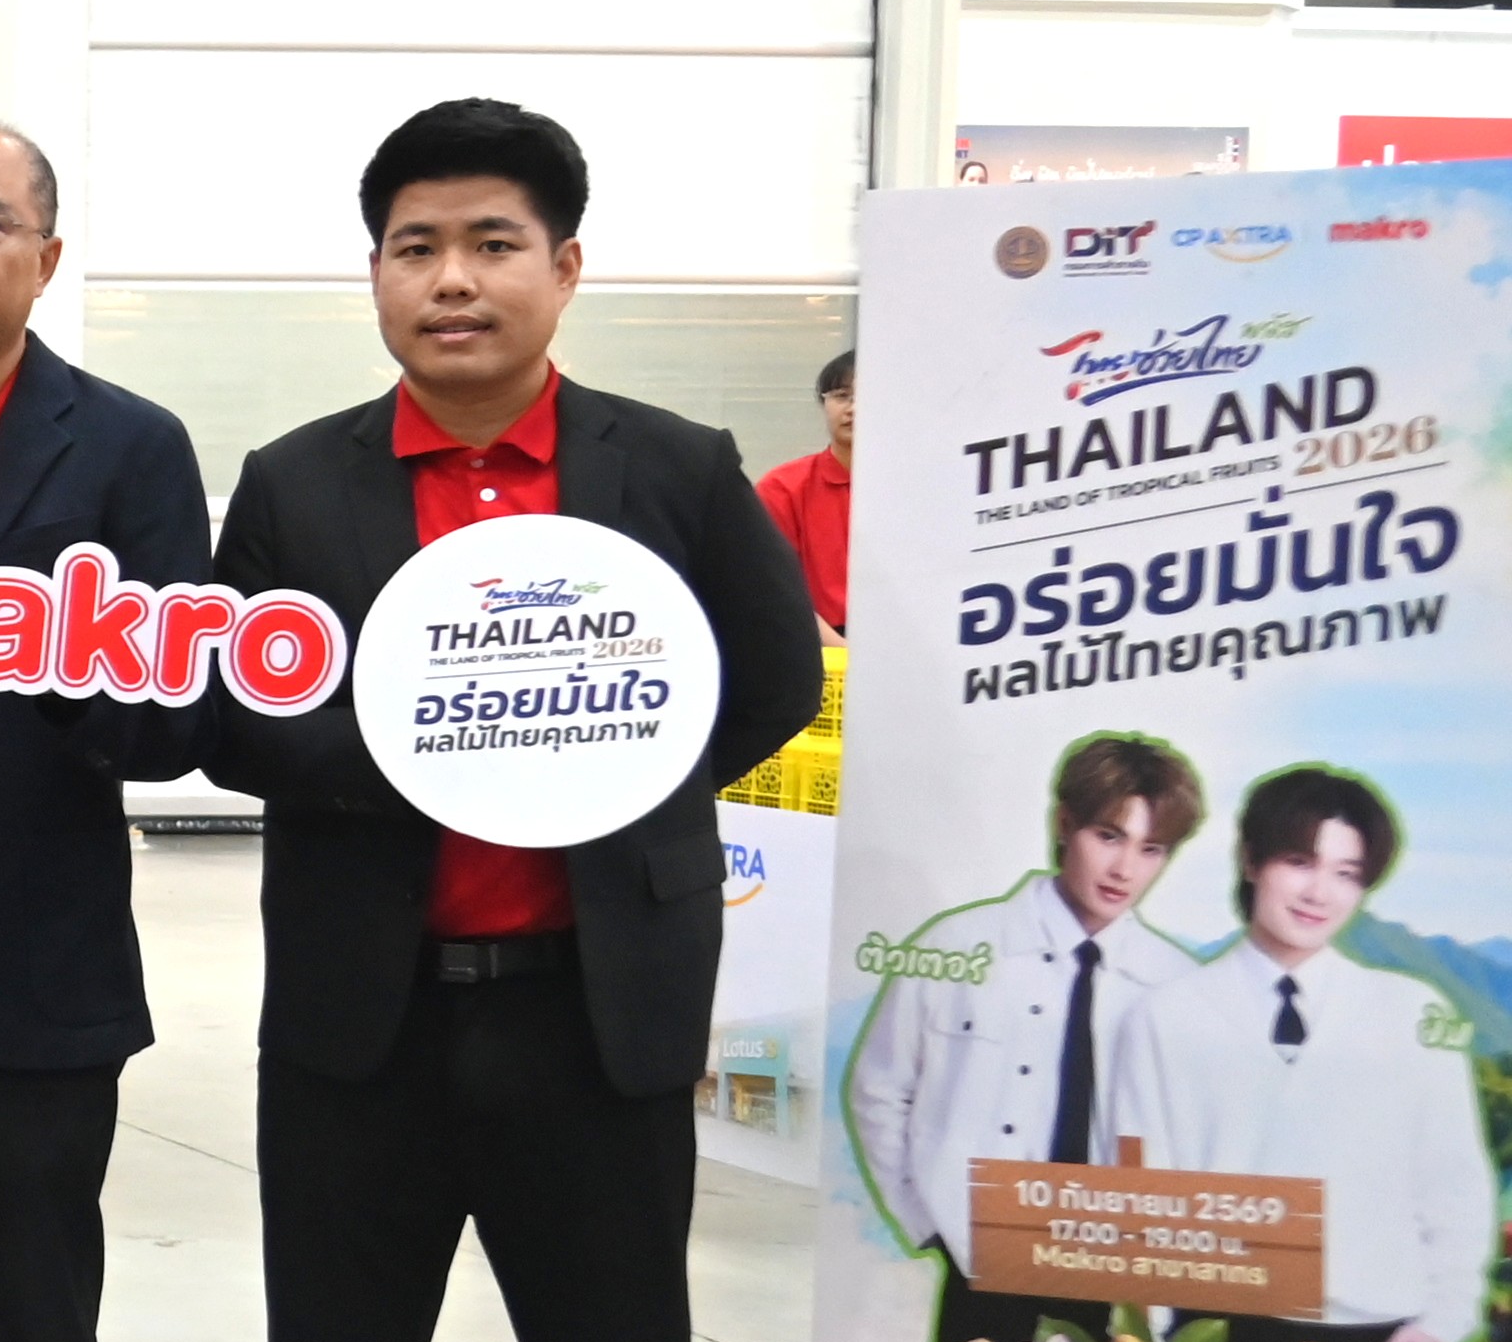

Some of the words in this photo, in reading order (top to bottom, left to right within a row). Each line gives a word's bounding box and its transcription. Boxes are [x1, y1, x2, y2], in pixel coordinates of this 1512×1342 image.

[1329, 216, 1429, 243] makro
[964, 365, 1378, 497] THAILAND
[1292, 415, 1439, 477] 2026
[975, 504, 1011, 526] THE
[1016, 493, 1071, 519] LAND
[1074, 487, 1103, 508] OF
[1106, 469, 1205, 504] TROPICAL
[1208, 455, 1280, 484] FRUITS
[958, 485, 1461, 647] อร่อยมั่นใจ
[426, 610, 636, 652] THAILAND
[592, 636, 664, 660] 2026
[964, 593, 1449, 705] ผลไม้ไทยคุณภาพ
[429, 657, 448, 667] THE
[450, 654, 479, 665] LAND
[481, 653, 495, 663] OF
[498, 650, 547, 662] TROPICAL
[550, 647, 585, 657] FRUITS
[414, 663, 670, 726] อร่อยมั่นใจ
[414, 720, 661, 755] ผลไม้ไทยคุณภาพ
[1014, 1180, 1052, 1207] 10
[1059, 1181, 1187, 1217] กันยายน
[1194, 1192, 1285, 1225] 2569
[1048, 1219, 1119, 1245] 17.00
[1142, 1226, 1214, 1253] 19.00
[1032, 1243, 1126, 1273] Makro
